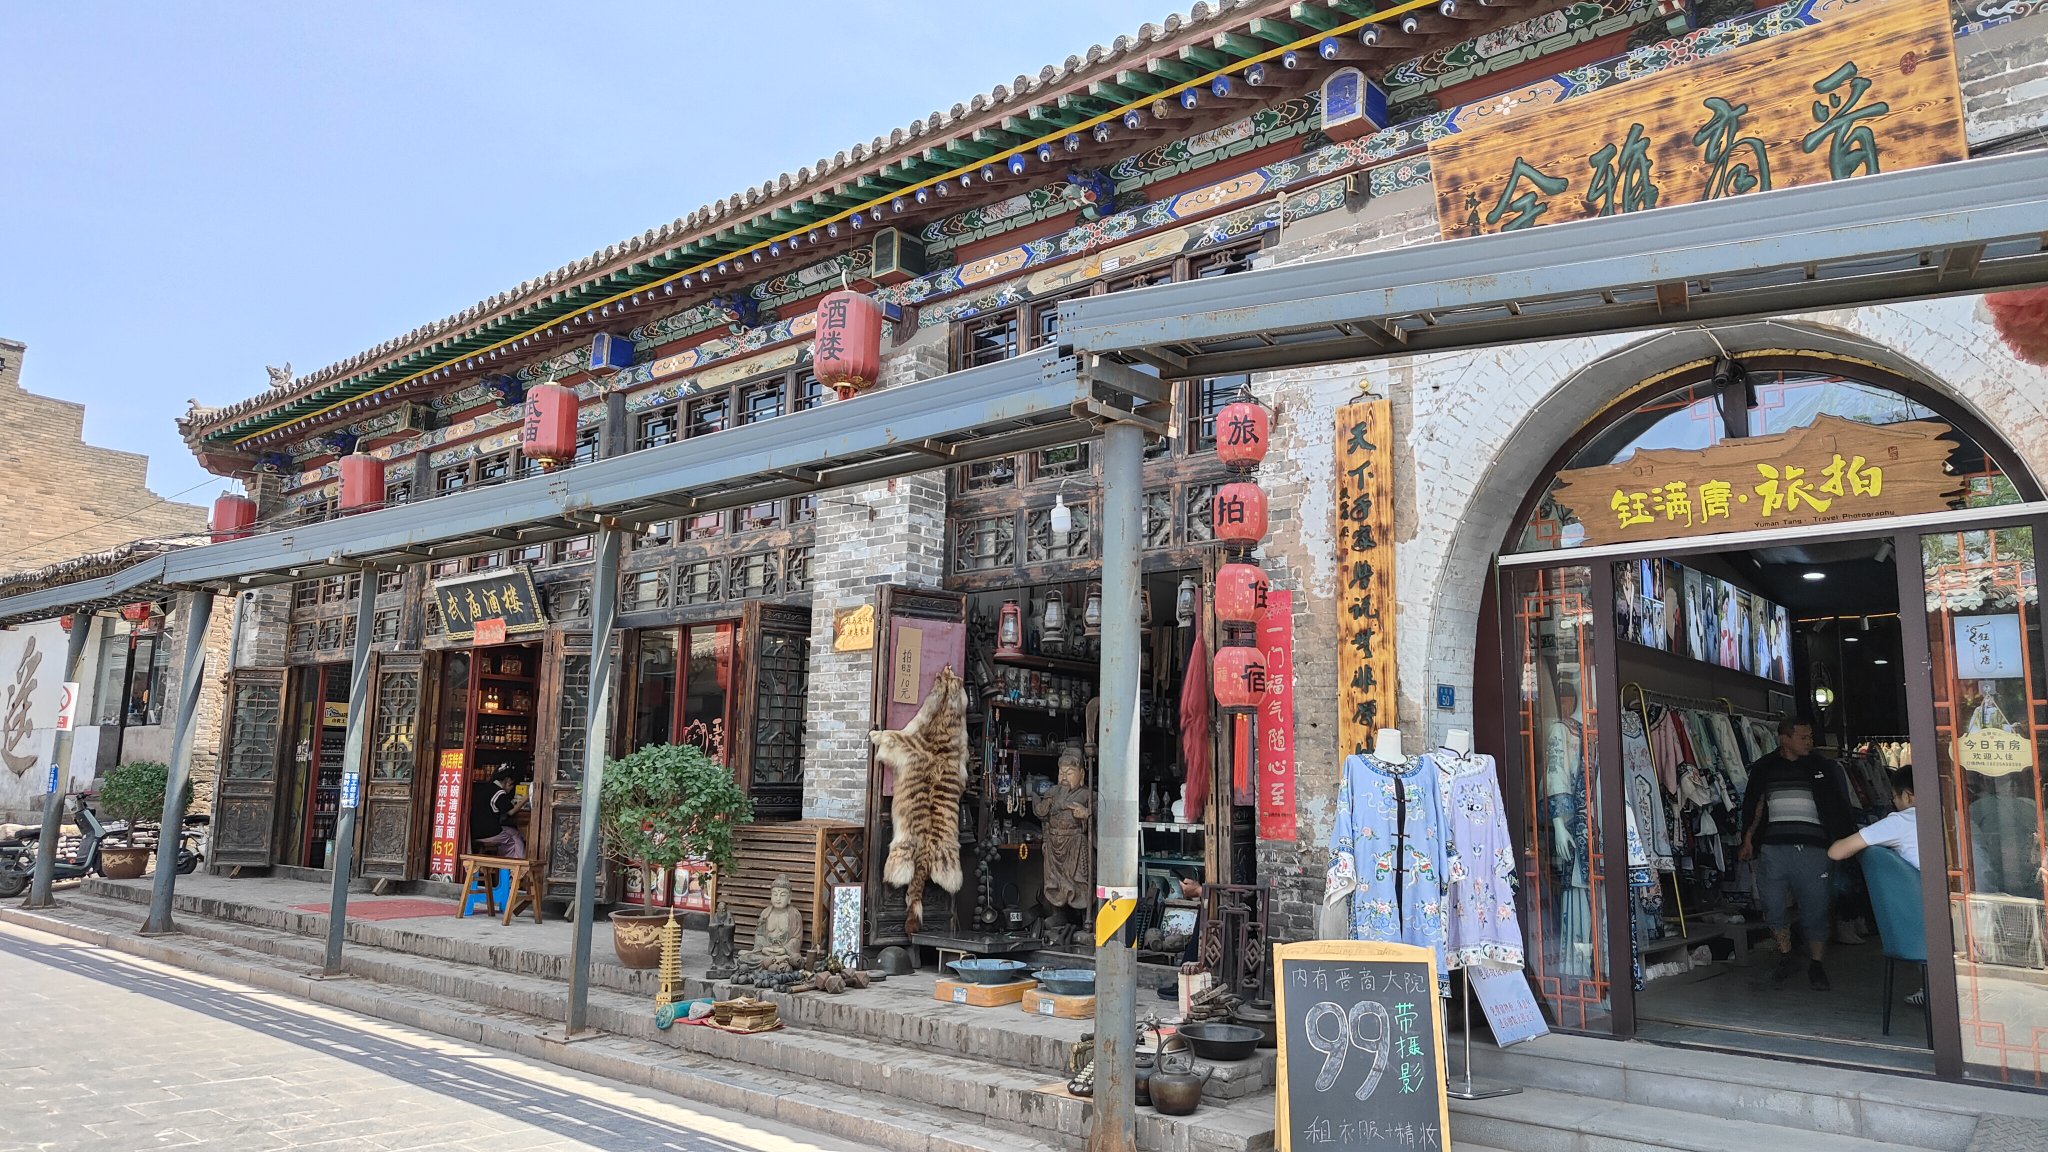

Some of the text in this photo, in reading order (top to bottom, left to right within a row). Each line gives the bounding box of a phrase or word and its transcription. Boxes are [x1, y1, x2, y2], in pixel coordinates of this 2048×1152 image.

[816, 298, 850, 362] 酒楼
[525, 393, 542, 442] 武庙
[1228, 414, 1260, 446] 旅
[1217, 495, 1245, 528] 拍
[1813, 514, 1839, 522] Travel
[1842, 510, 1896, 520] Photography
[446, 582, 524, 623] 武庙酒楼
[1248, 579, 1269, 609] 住
[1241, 662, 1266, 694] 宿
[1266, 626, 1288, 807] 一门福气随心至
[441, 752, 463, 769] 本店特色
[1964, 739, 2021, 751] 今日有房
[1973, 752, 2014, 761] 欢迎入住
[1292, 967, 1427, 994] 内有晋商大院
[1305, 1000, 1390, 1101] 99
[1394, 1002, 1425, 1094] 带摄影
